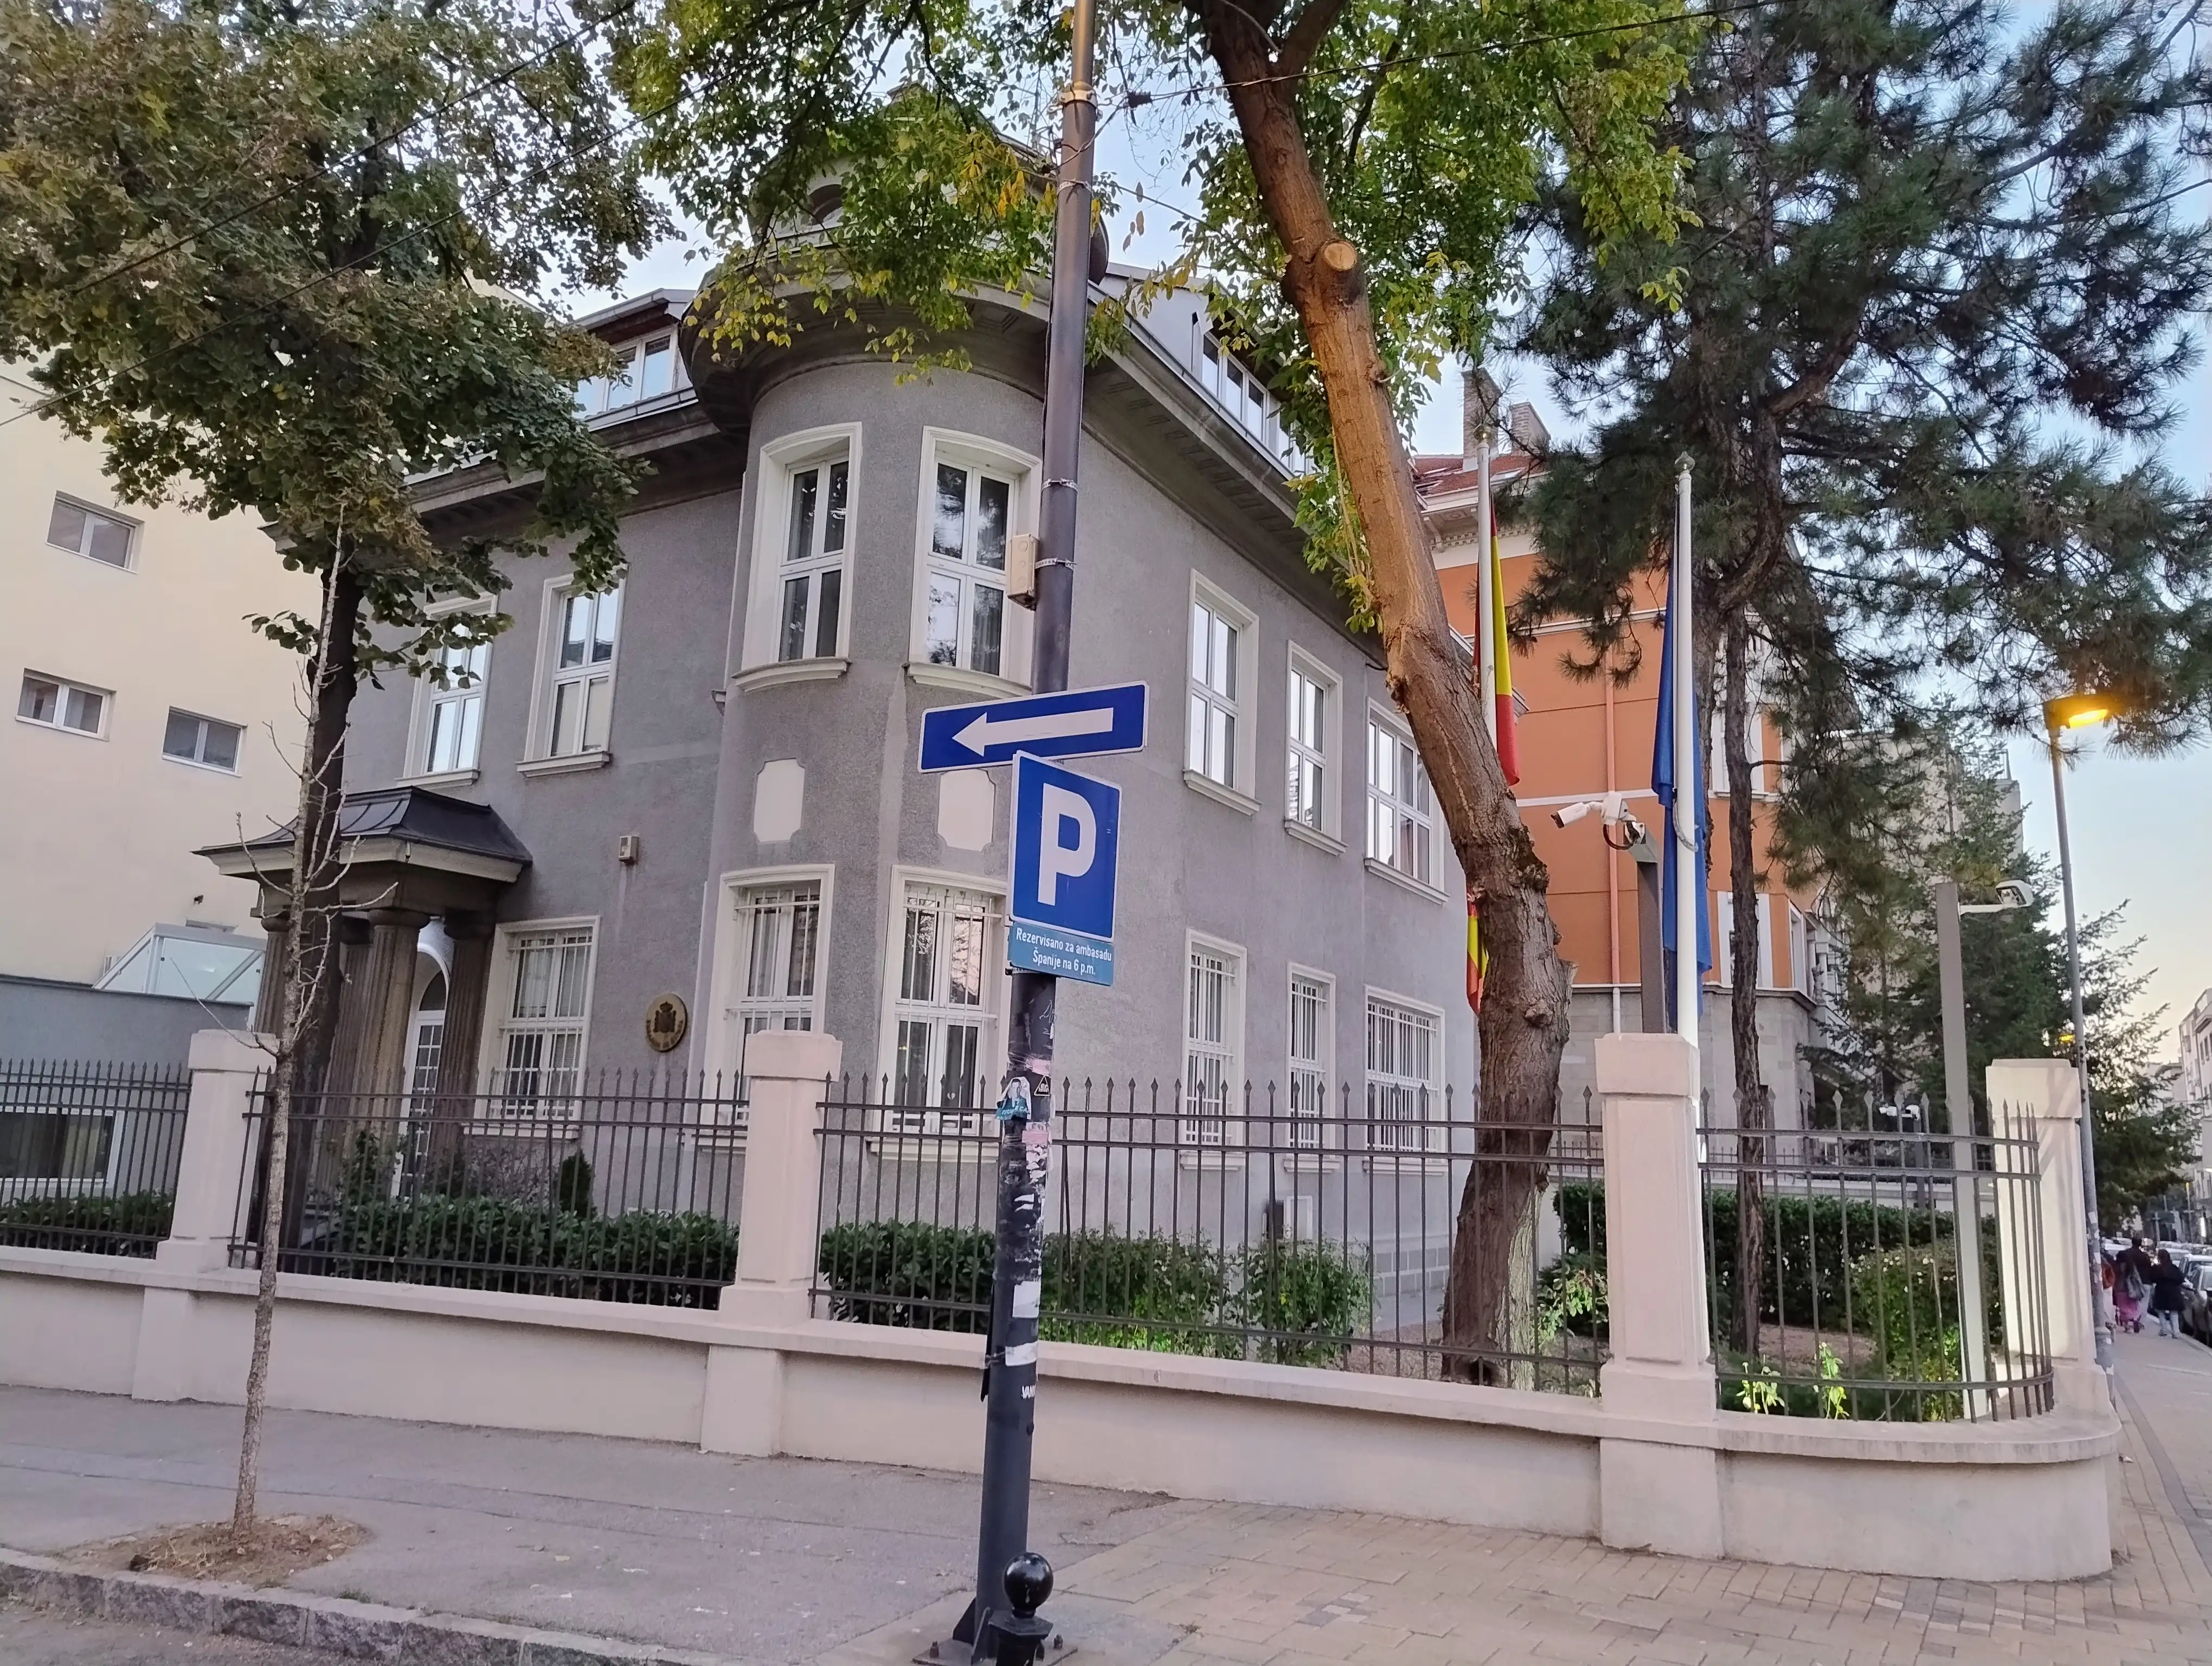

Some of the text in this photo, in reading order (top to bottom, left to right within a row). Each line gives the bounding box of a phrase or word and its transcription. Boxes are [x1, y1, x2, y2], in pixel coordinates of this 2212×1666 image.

[1038, 783, 1096, 906] P
[1016, 927, 1111, 962] Rezervisano za ambasadu
[1032, 946, 1096, 976] Španije na 6 p.m.
